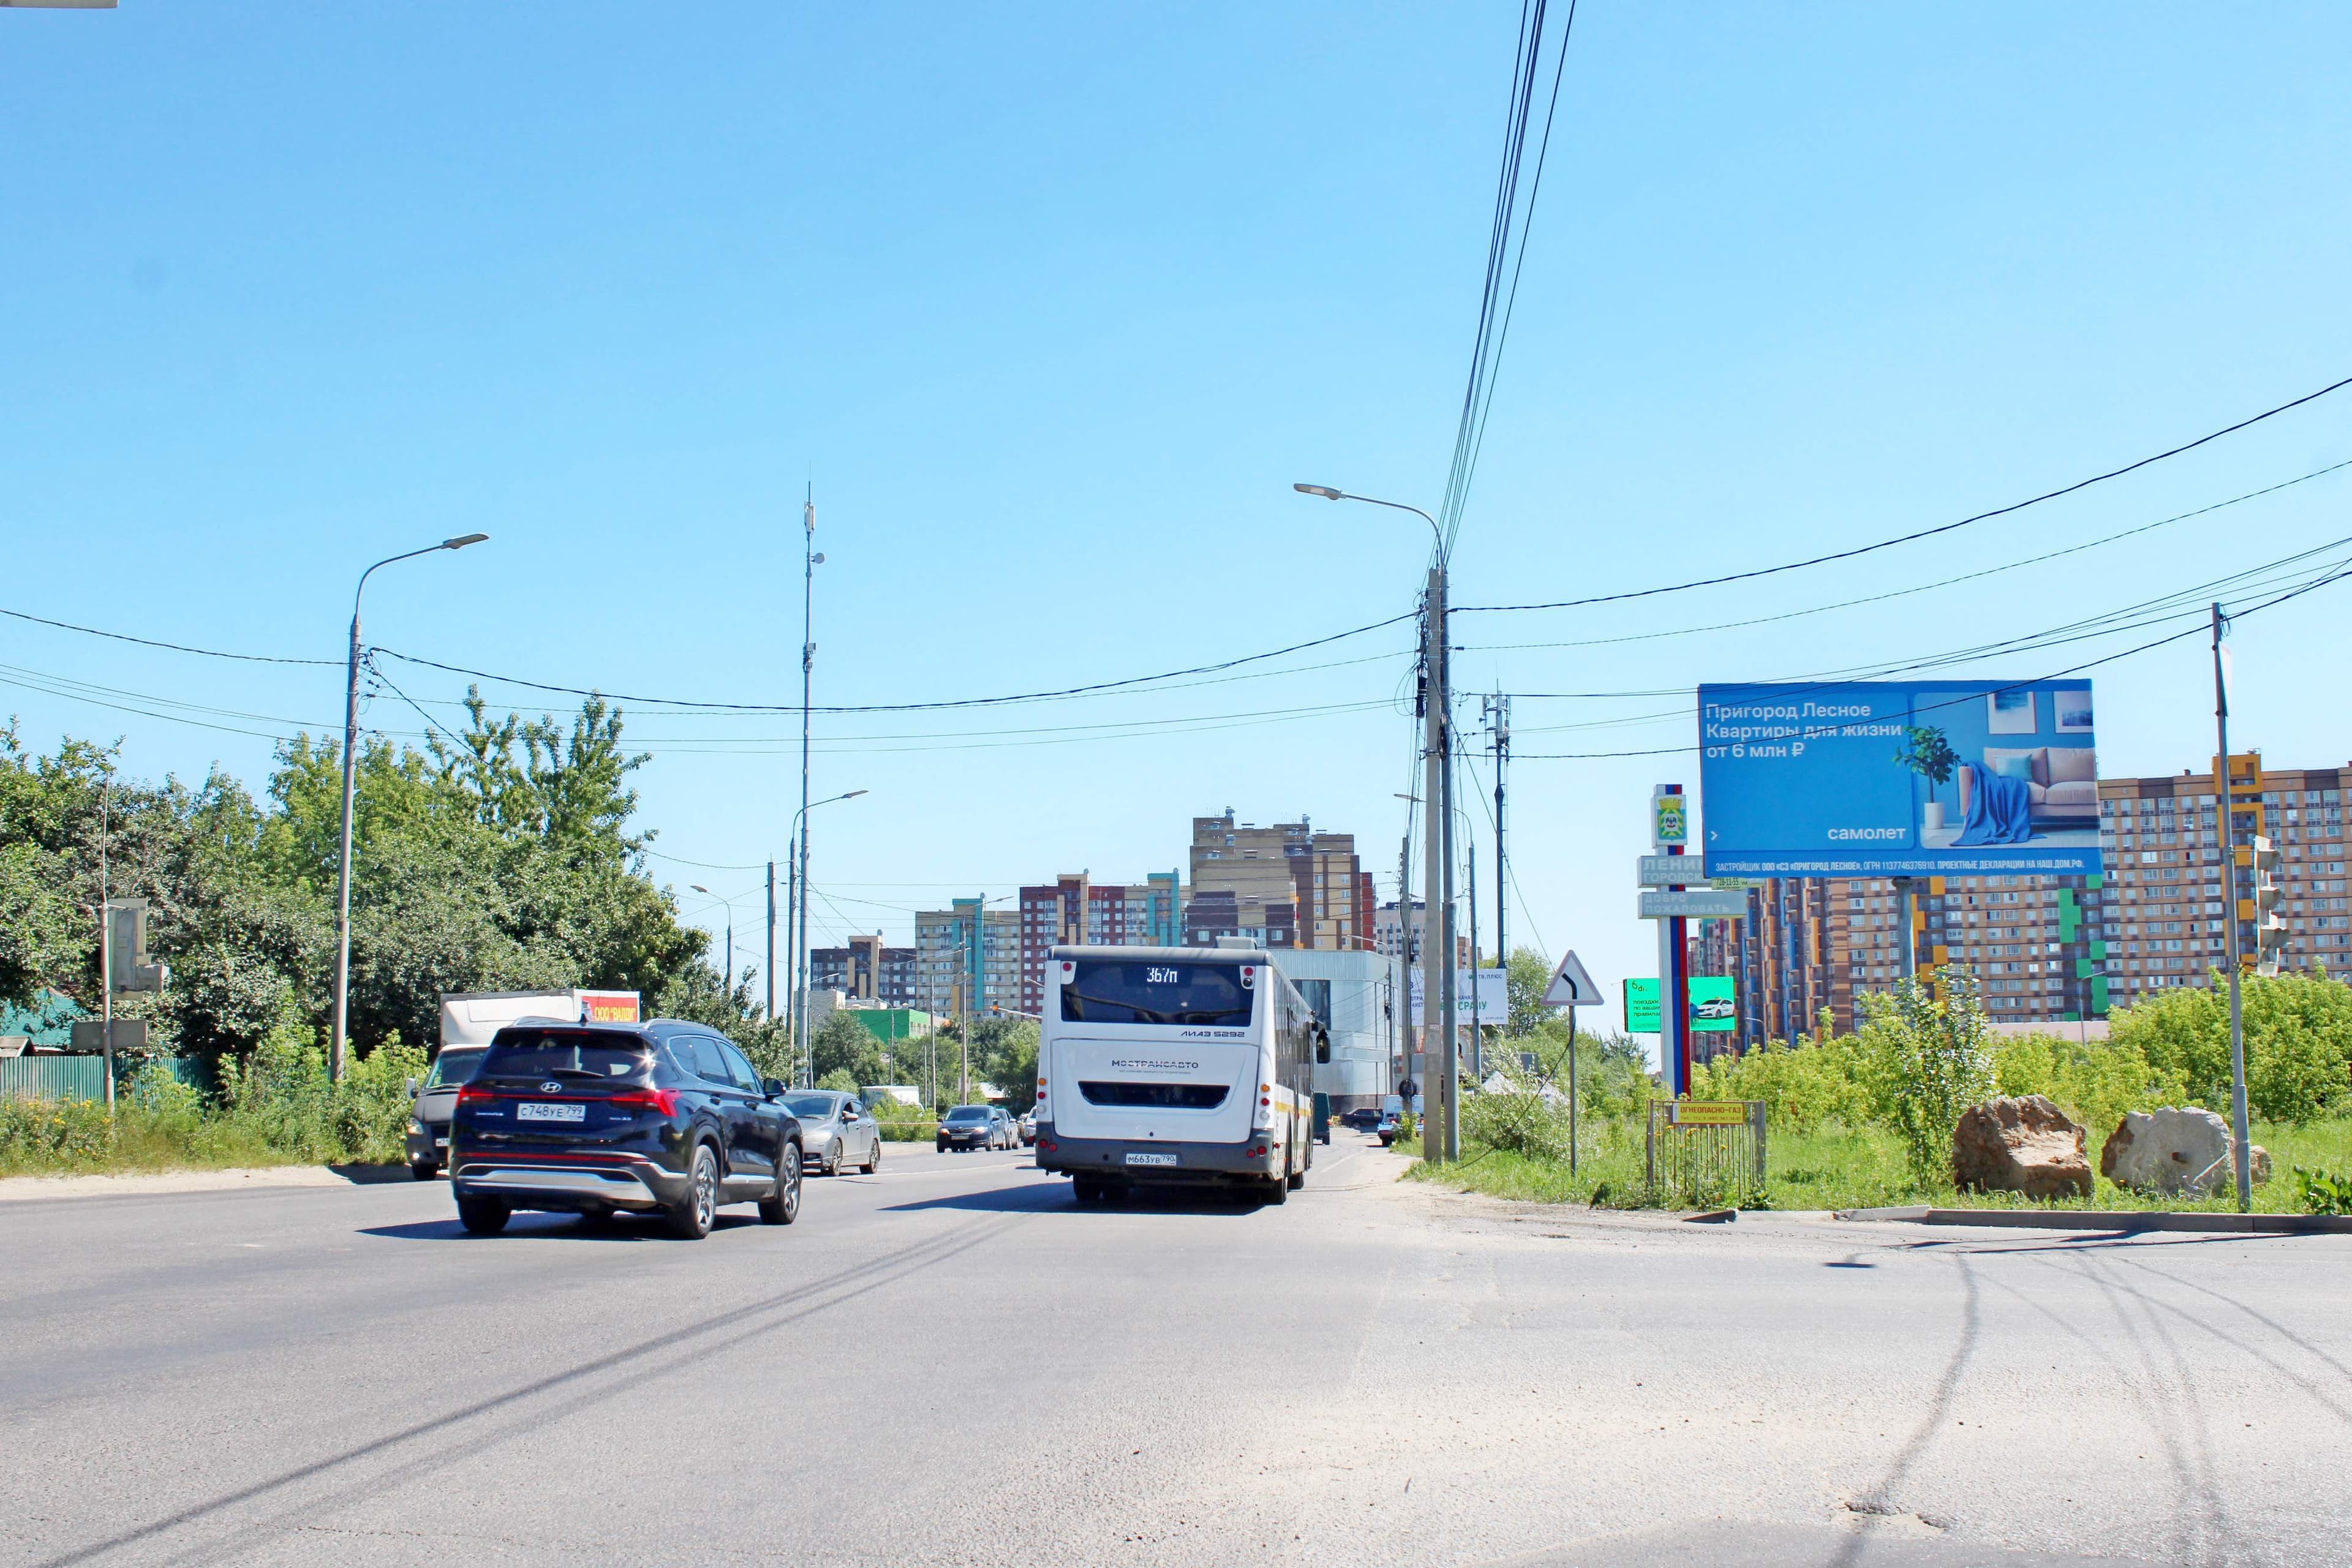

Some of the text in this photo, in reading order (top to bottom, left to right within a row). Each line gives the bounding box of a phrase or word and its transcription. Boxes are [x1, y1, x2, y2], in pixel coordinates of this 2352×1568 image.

[1706, 703, 1871, 722] Пригород Лесное
[1706, 723, 1902, 741] Квартиры для жизни
[1706, 747, 1727, 758] от
[1732, 743, 1745, 758] 6
[1749, 745, 1787, 758] млн
[1827, 827, 1907, 840] самолет
[1715, 862, 1761, 872] ЗАСТРОЙЩИК
[1762, 862, 1775, 871] ООО
[1863, 861, 1880, 870] ОГРН
[1937, 860, 1978, 870] ПРОЕКТНЫЕ
[1979, 860, 2026, 870] ДЕКЛАРАЦИИ
[2026, 859, 2036, 869] НА
[1645, 894, 1687, 903] ДОБРО
[1646, 904, 1730, 913] ПОЖАЛОВАТЬ
[1112, 1060, 1199, 1069] МОСТРАНСАВТО
